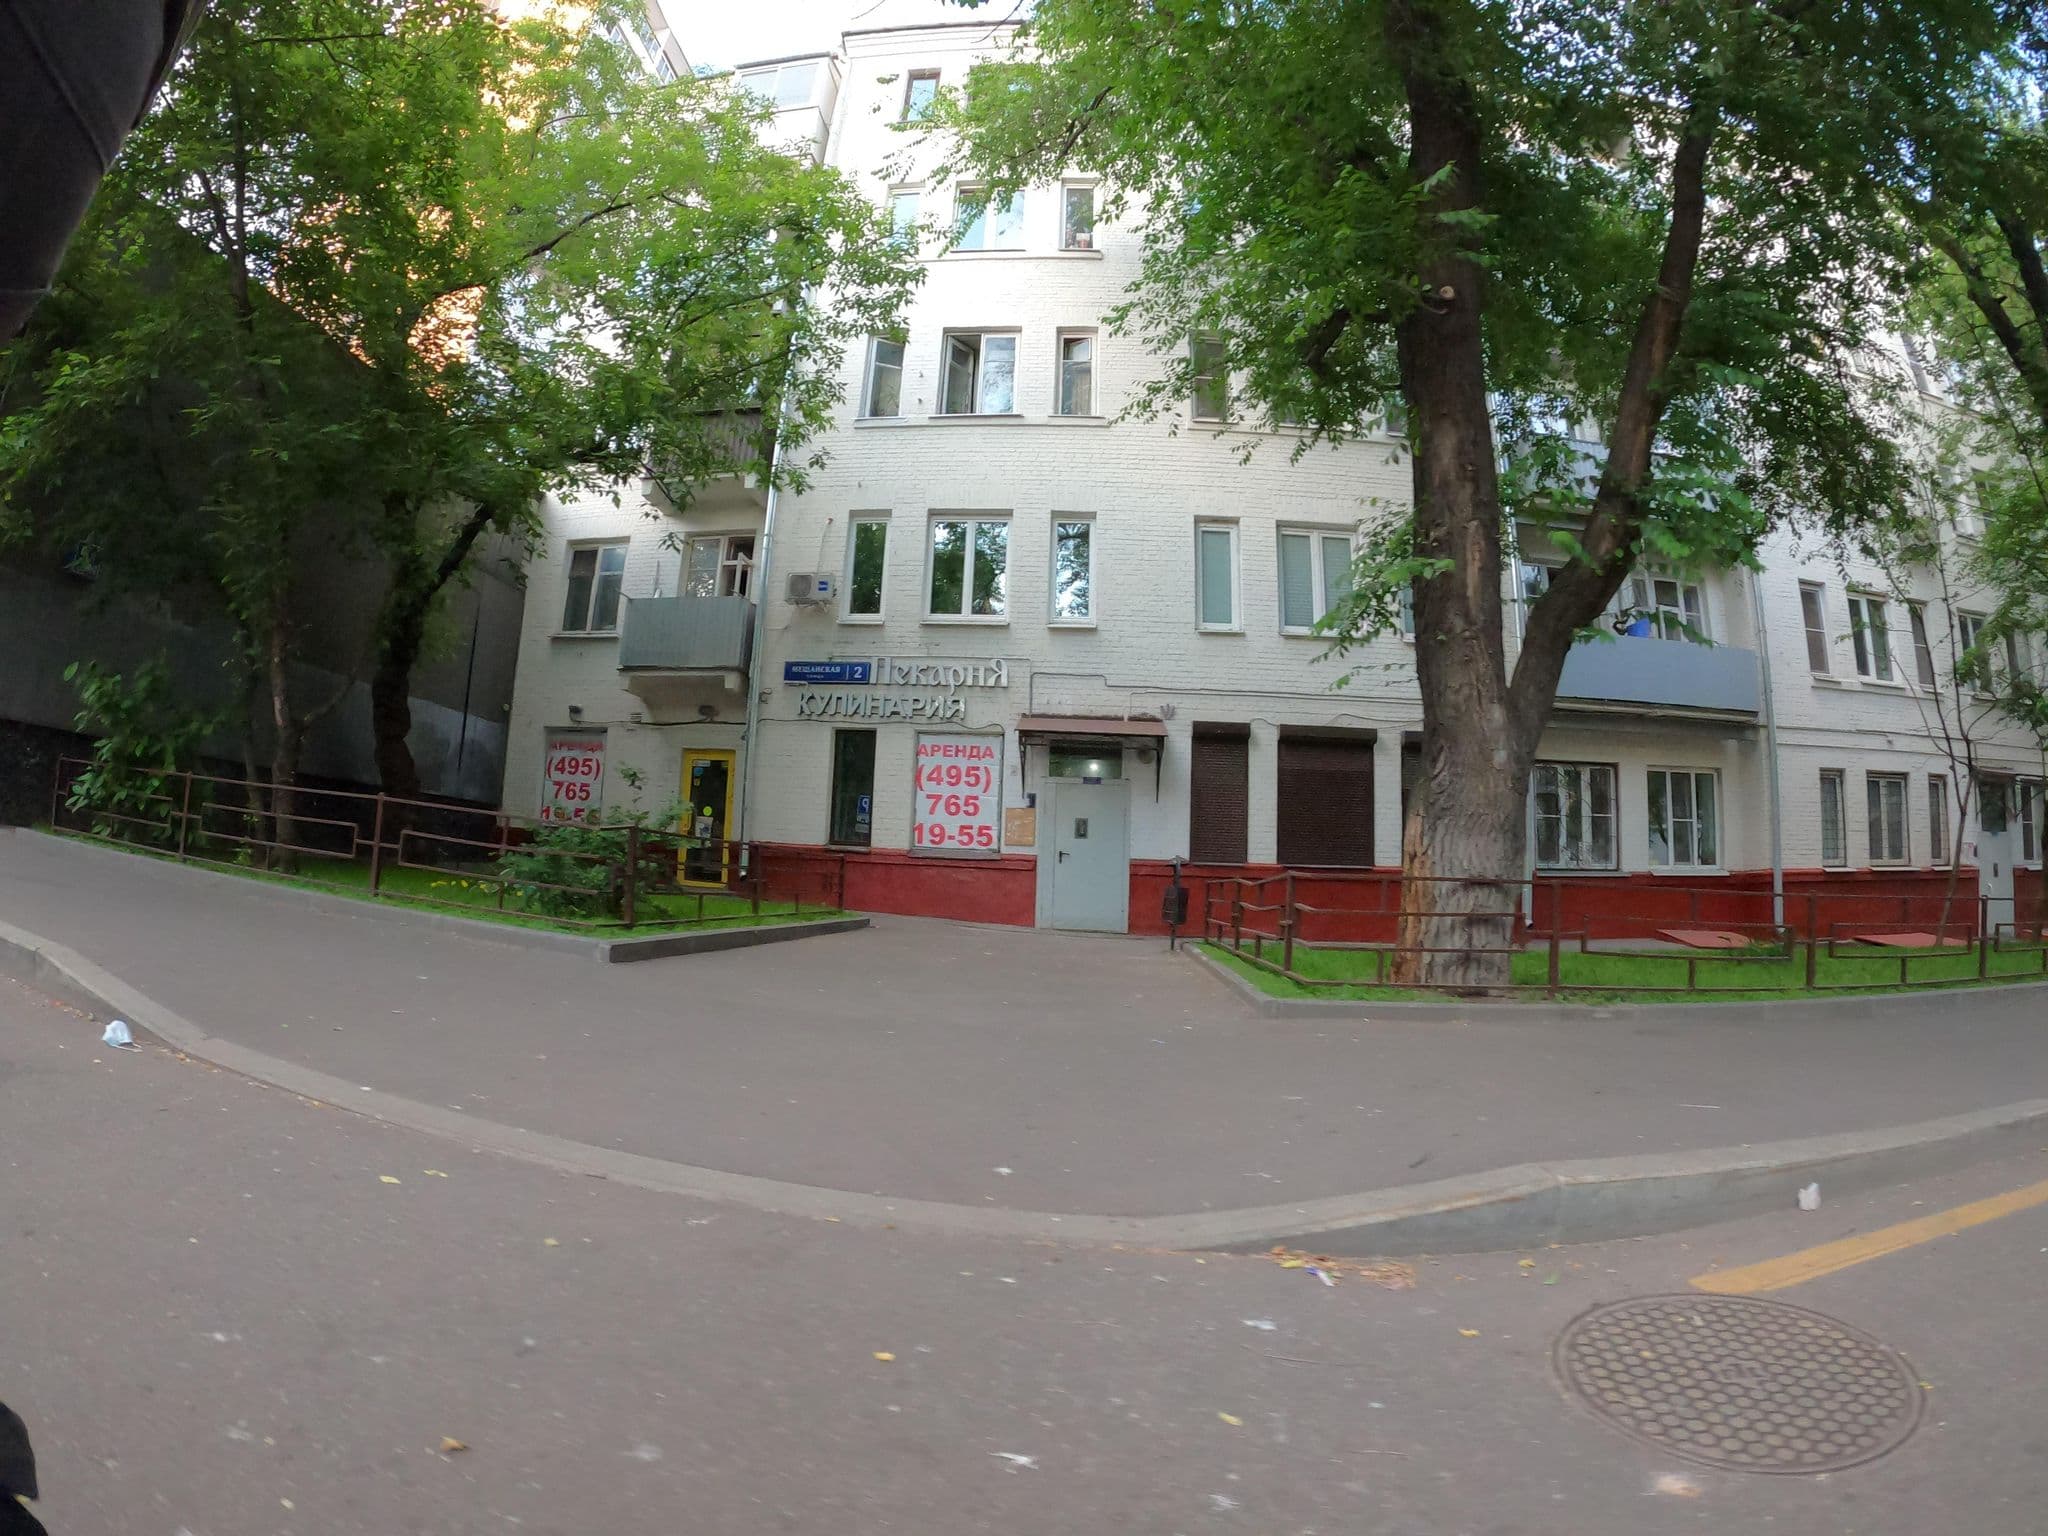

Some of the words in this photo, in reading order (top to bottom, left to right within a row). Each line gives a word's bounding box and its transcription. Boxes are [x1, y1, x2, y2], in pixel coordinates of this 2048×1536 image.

[853, 666, 863, 679] 2
[797, 692, 967, 721] КУЛИНАРИЯ
[916, 743, 994, 760] АРЕНДА
[547, 756, 600, 781] (495)
[914, 764, 992, 794] (495)
[552, 780, 591, 801] 765
[926, 793, 981, 817] 765
[913, 822, 994, 848] 19-55
